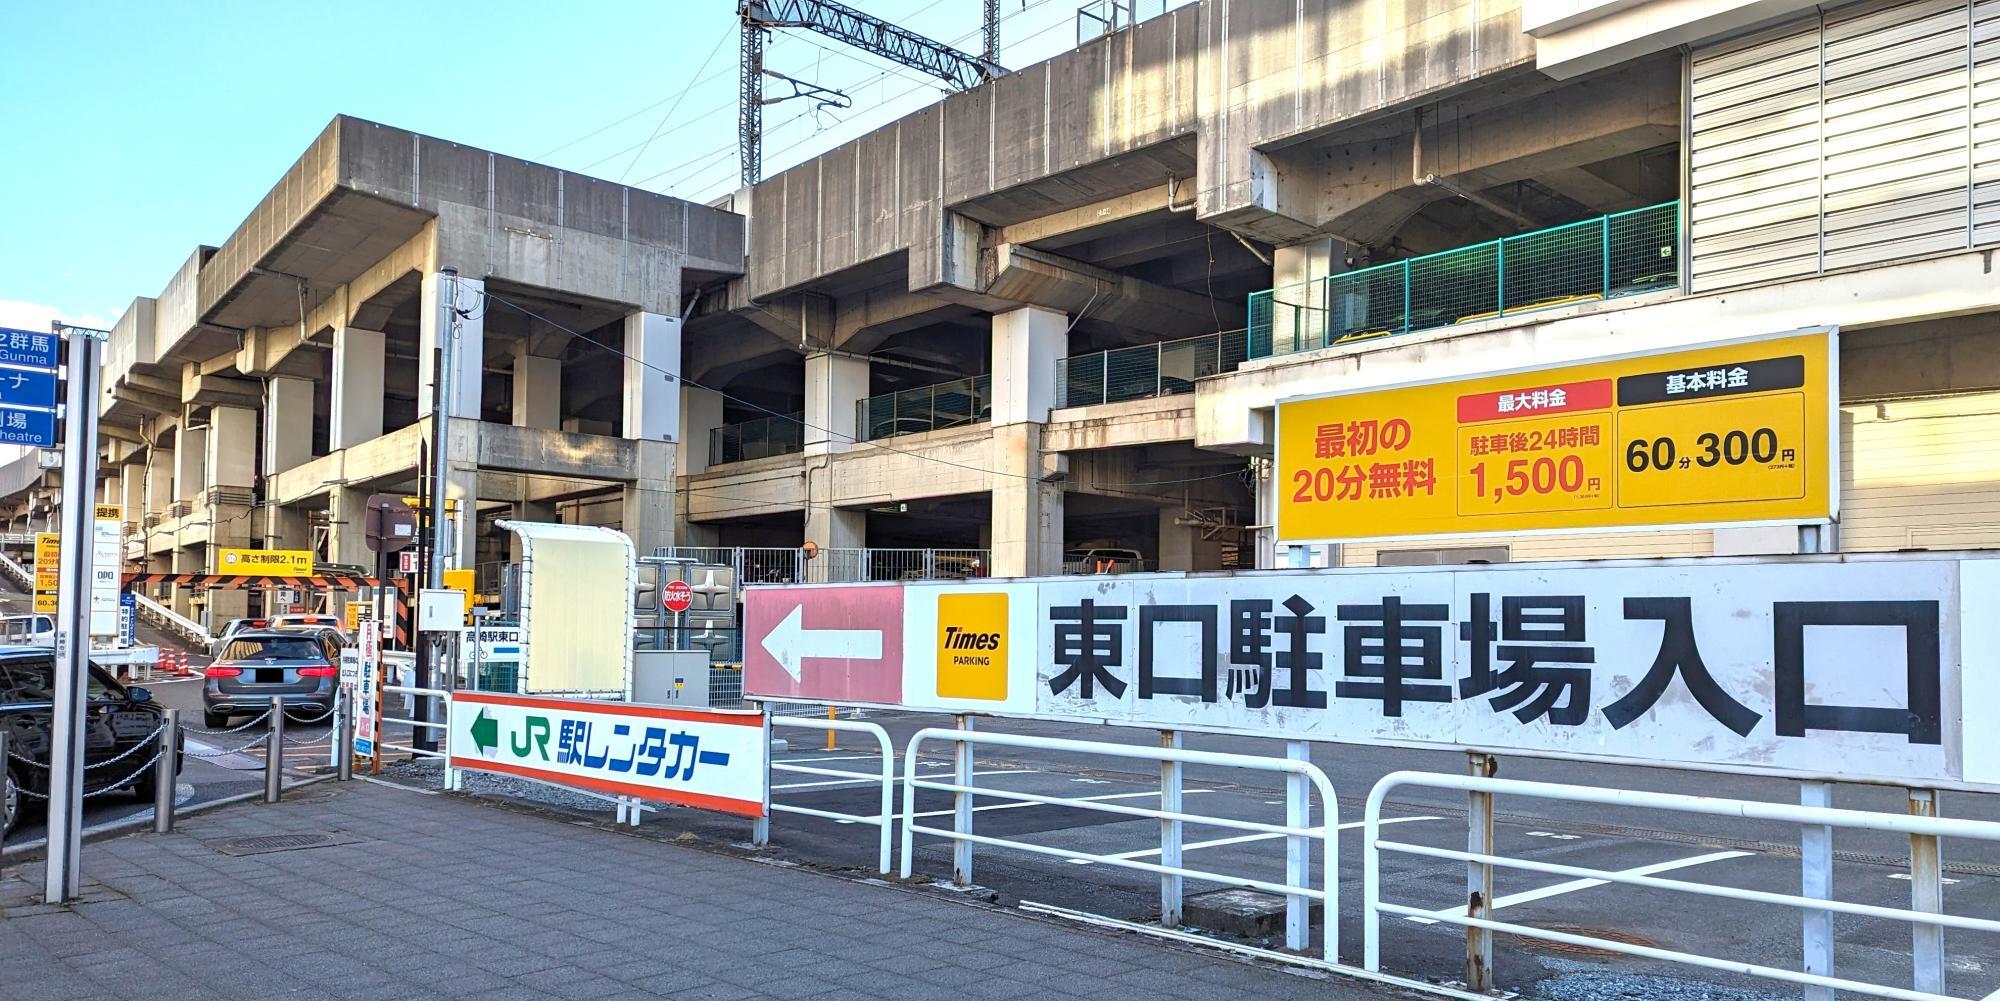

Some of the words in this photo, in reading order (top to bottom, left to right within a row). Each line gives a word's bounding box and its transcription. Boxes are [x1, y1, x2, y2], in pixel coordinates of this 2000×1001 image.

[0, 350, 48, 365] Gunma
[1666, 367, 1749, 396] 基本料金
[1497, 388, 1567, 413] 最大料金
[0, 411, 27, 430] 場
[1314, 418, 1412, 460] 最初の
[1470, 425, 1601, 456] 駐車後24時間
[1292, 457, 1438, 503] 20分無料
[1469, 454, 1602, 504] 1,500円
[96, 507, 120, 519] 提携
[241, 554, 307, 564] 高さ制限2.1m
[664, 591, 691, 602] 防火水そう
[466, 630, 520, 643] 高崎駅東口
[943, 626, 1001, 651] Times
[953, 656, 991, 668] PARKING
[1049, 592, 1942, 746] 東口駐車場入口
